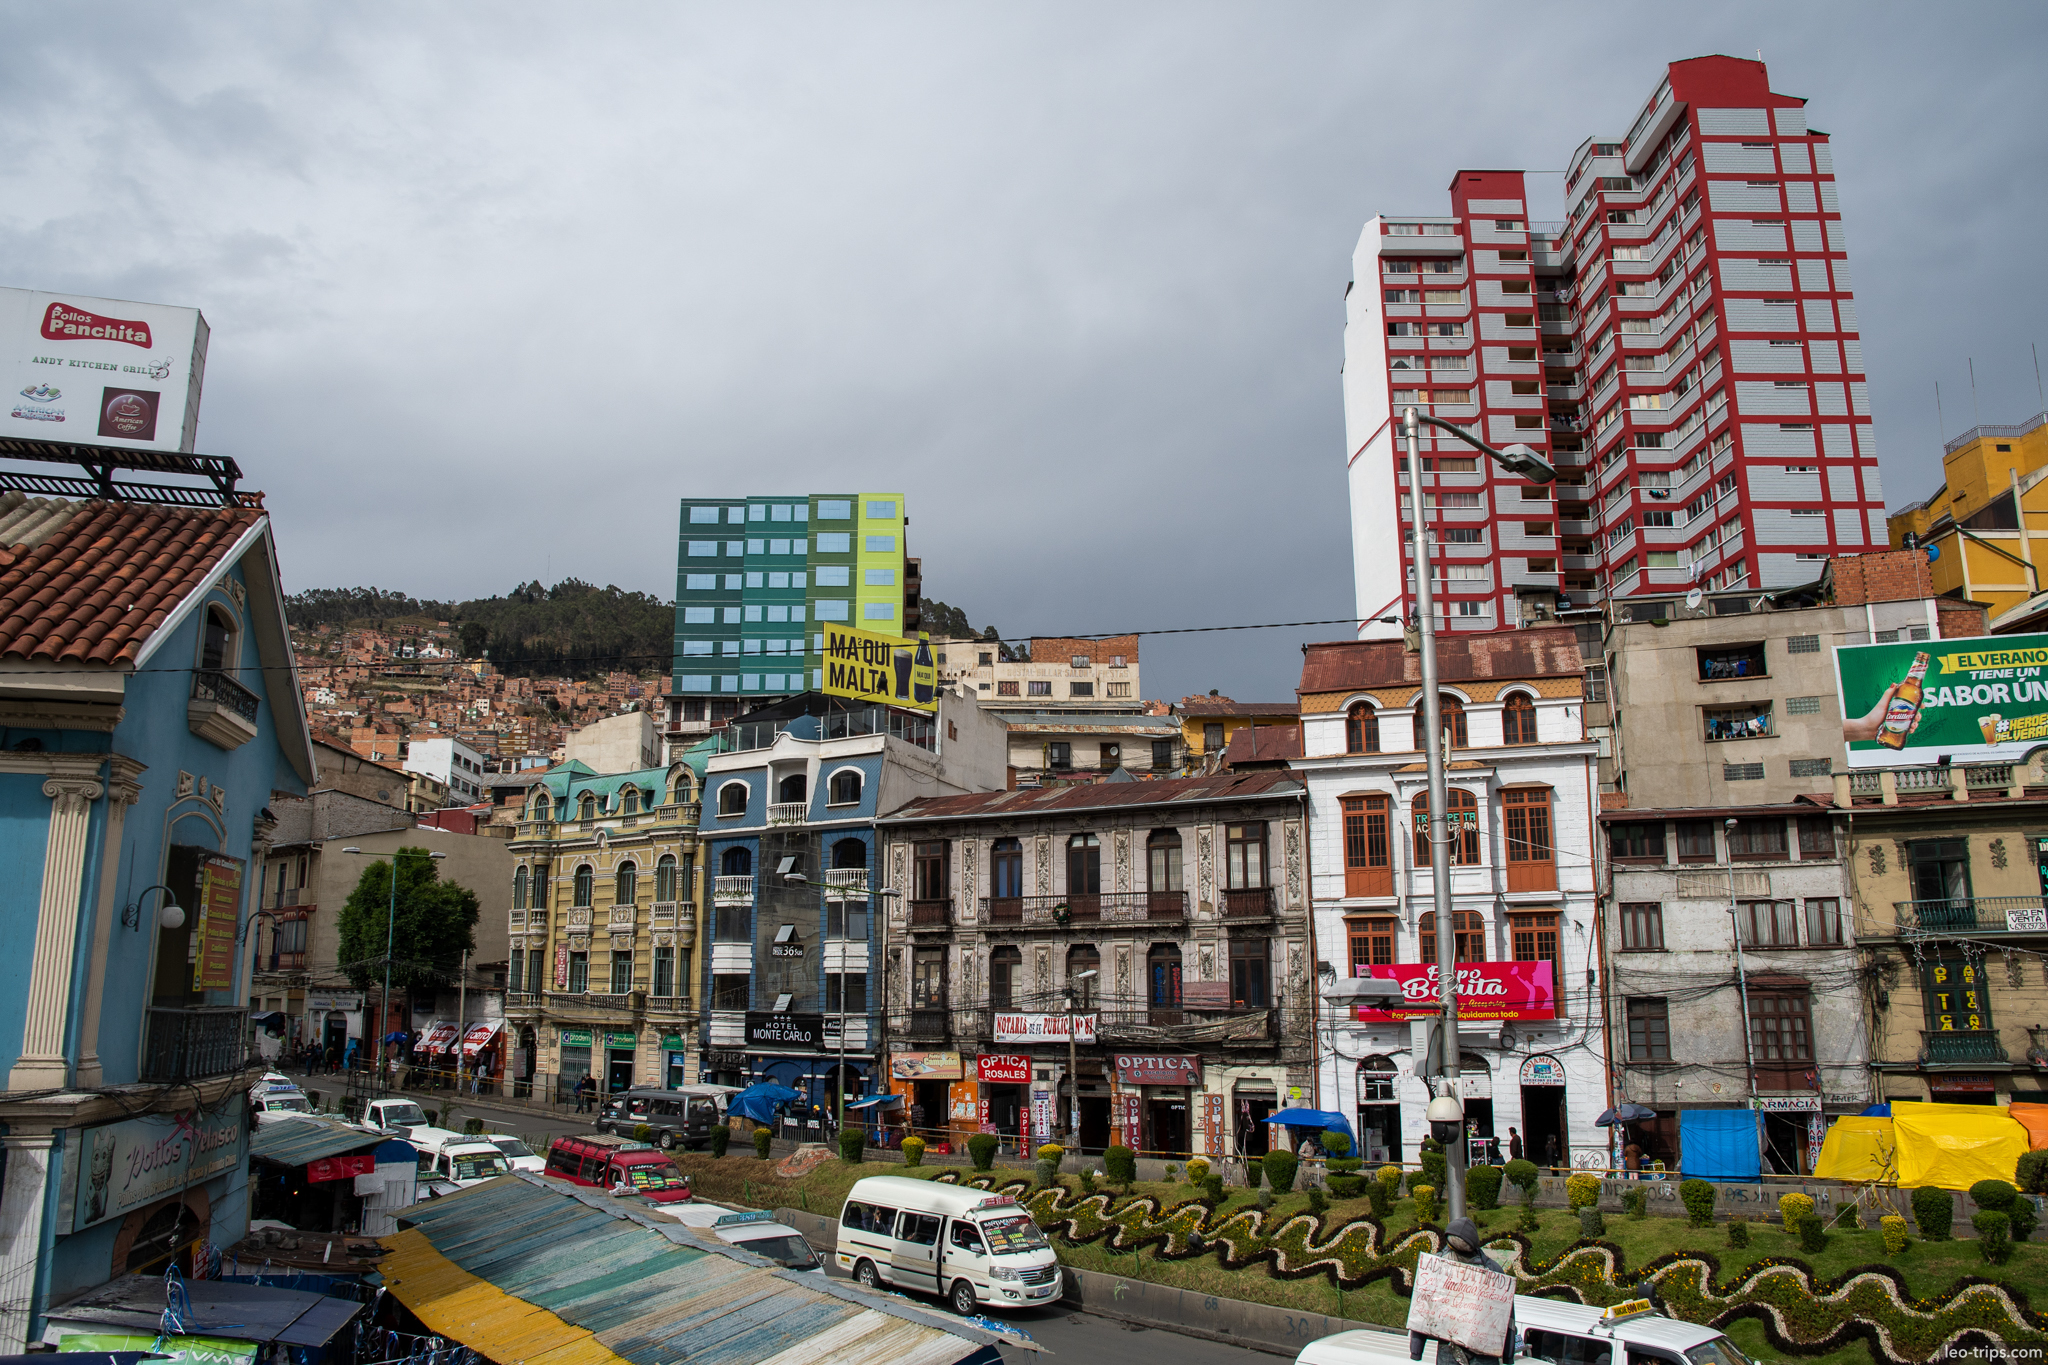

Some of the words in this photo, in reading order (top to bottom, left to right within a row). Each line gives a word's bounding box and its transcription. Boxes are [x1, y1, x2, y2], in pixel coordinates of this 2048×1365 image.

[52, 310, 92, 323] Pollos
[49, 319, 147, 342] Panchita
[32, 356, 64, 366] ANDY
[69, 360, 118, 371] KITCHEN
[123, 365, 155, 375] GRILL
[13, 404, 65, 416] AMERICAN
[112, 416, 143, 425] American
[118, 423, 137, 431] Coffee
[1958, 655, 1977, 667] EL
[1978, 651, 2048, 666] VERANO
[829, 662, 889, 696] MALTA
[1969, 669, 2014, 680] TIENE
[2016, 667, 2040, 677] UN
[1923, 683, 2011, 707] SABOR
[1415, 811, 1476, 823] TRPETA
[783, 946, 794, 956] 36
[1501, 1010, 1519, 1018] todo
[765, 1022, 798, 1030] HOTEL
[996, 1016, 1027, 1034] NOTARIA
[468, 1031, 491, 1040] TORITO
[570, 1034, 590, 1042] prodem
[614, 1035, 634, 1044] prodem
[753, 1029, 781, 1040] MONTE
[783, 1031, 811, 1042] CARLO
[708, 1051, 747, 1064] OPTICA
[981, 1055, 1027, 1070] OPTICA
[1118, 1057, 1193, 1069] OPTICA
[1522, 1056, 1563, 1078] ALOJAMIENTO
[985, 1070, 1026, 1079] ROSALES
[784, 1117, 798, 1126] PARADA
[807, 1120, 820, 1129] HOTEL
[1129, 1098, 1140, 1154] OPICA
[1212, 1096, 1222, 1154] OPICA
[124, 1138, 182, 1190] Pollos
[183, 1124, 238, 1166] Velasco
